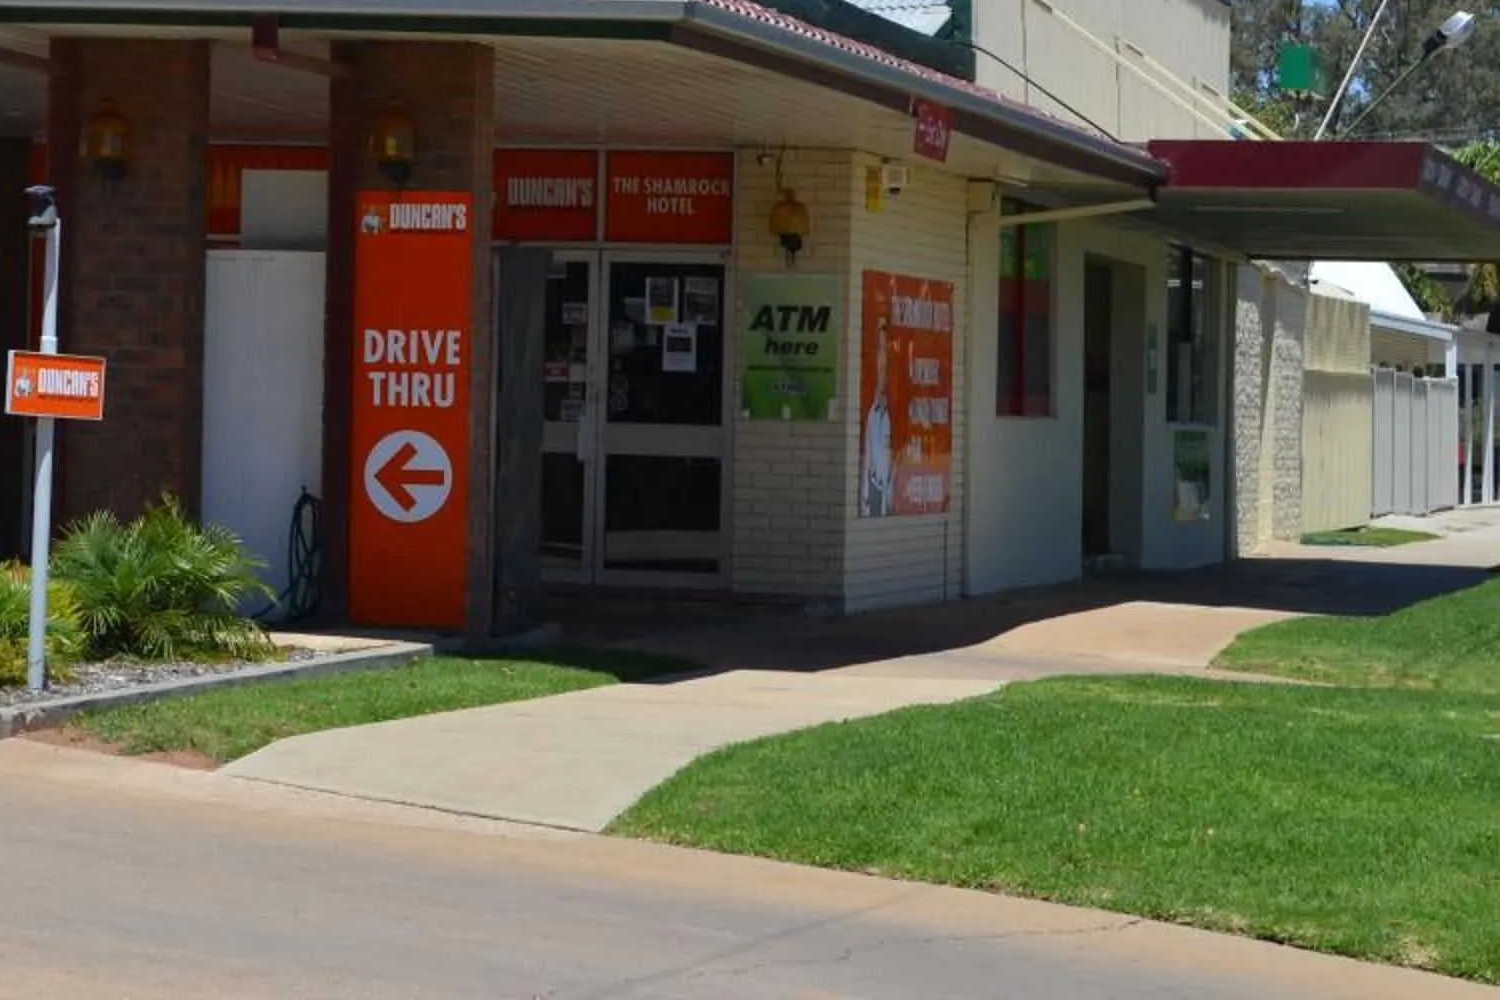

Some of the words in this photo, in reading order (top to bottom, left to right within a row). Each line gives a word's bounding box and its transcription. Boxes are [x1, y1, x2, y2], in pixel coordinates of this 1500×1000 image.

[507, 176, 594, 207] DUNCAN'S
[613, 176, 641, 195] THE
[644, 178, 730, 196] SHAMROCK
[389, 202, 467, 230] DUNCAN'S
[647, 197, 694, 215] HOTEL
[749, 304, 832, 333] ATM
[364, 329, 461, 365] DRIVE
[764, 337, 819, 356] here
[37, 367, 99, 397] DUNCAN'S
[368, 371, 455, 408] THRU
